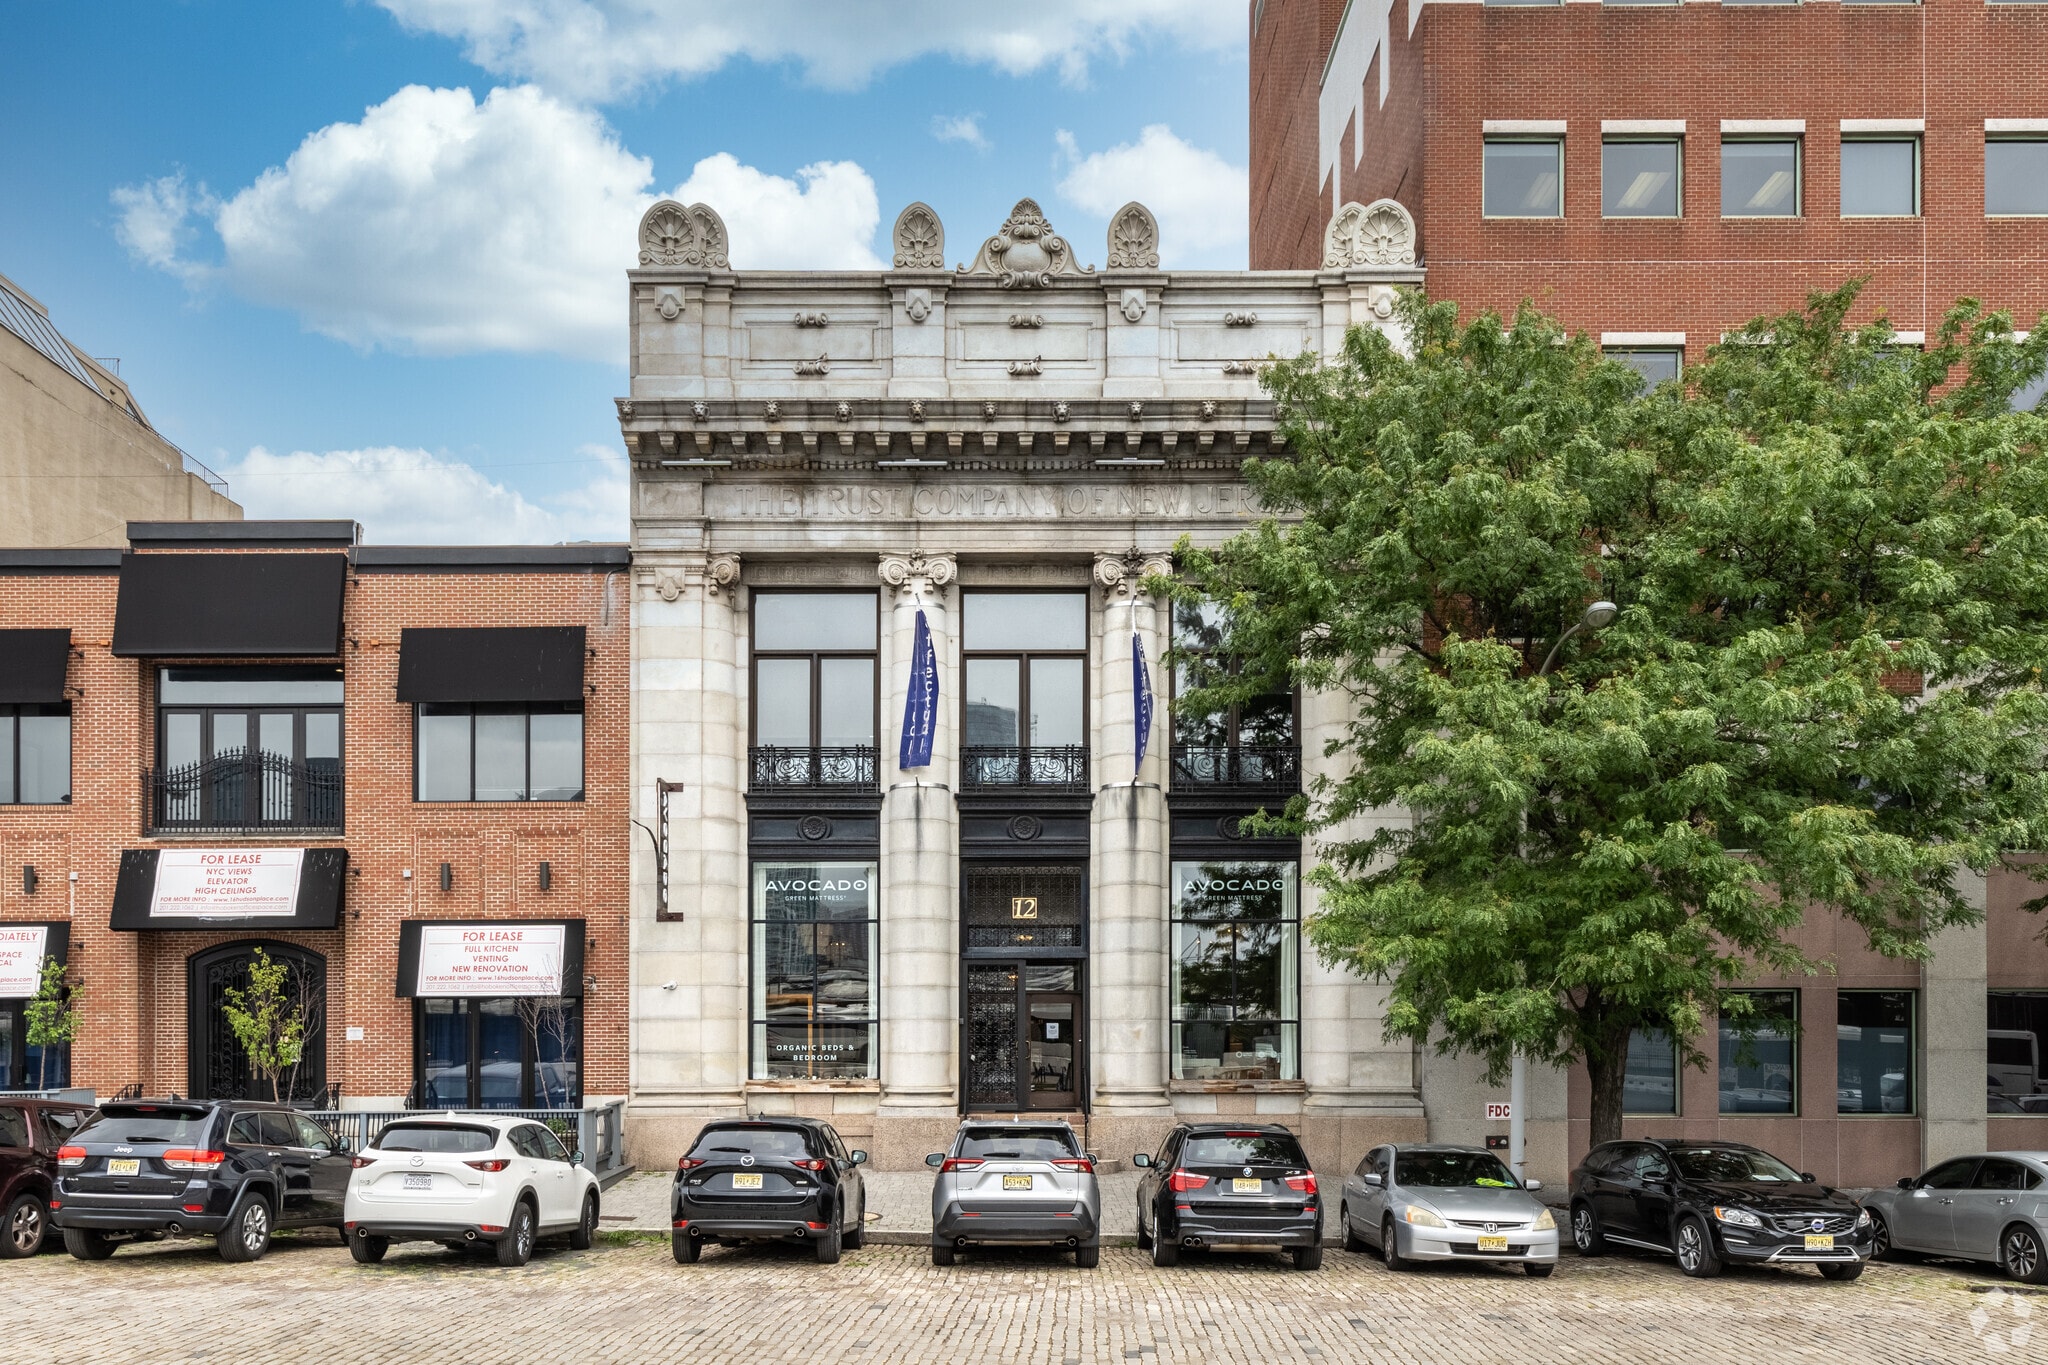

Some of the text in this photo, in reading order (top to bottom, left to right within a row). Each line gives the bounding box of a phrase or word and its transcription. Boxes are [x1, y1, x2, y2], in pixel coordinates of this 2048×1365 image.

[735, 486, 798, 515] THE
[806, 486, 902, 515] TRUST
[914, 487, 1061, 515] COMPANY
[1068, 486, 1110, 515] OF
[1117, 486, 1185, 514] NEW
[200, 854, 262, 865] FOR LEASE
[206, 868, 226, 876] NYC
[207, 877, 249, 885] ELEVATOR
[765, 879, 867, 892] AVOCADO
[1183, 879, 1285, 892] AVOCADO
[194, 886, 257, 895] HIGH CEILINGS
[1014, 899, 1036, 918] 12
[463, 931, 523, 942] FOR LEASE
[464, 945, 519, 953] FULL KITCHEN
[472, 955, 509, 963] VENTING
[452, 965, 529, 973] NEW RENOVATION
[1488, 1105, 1510, 1117] FDC
